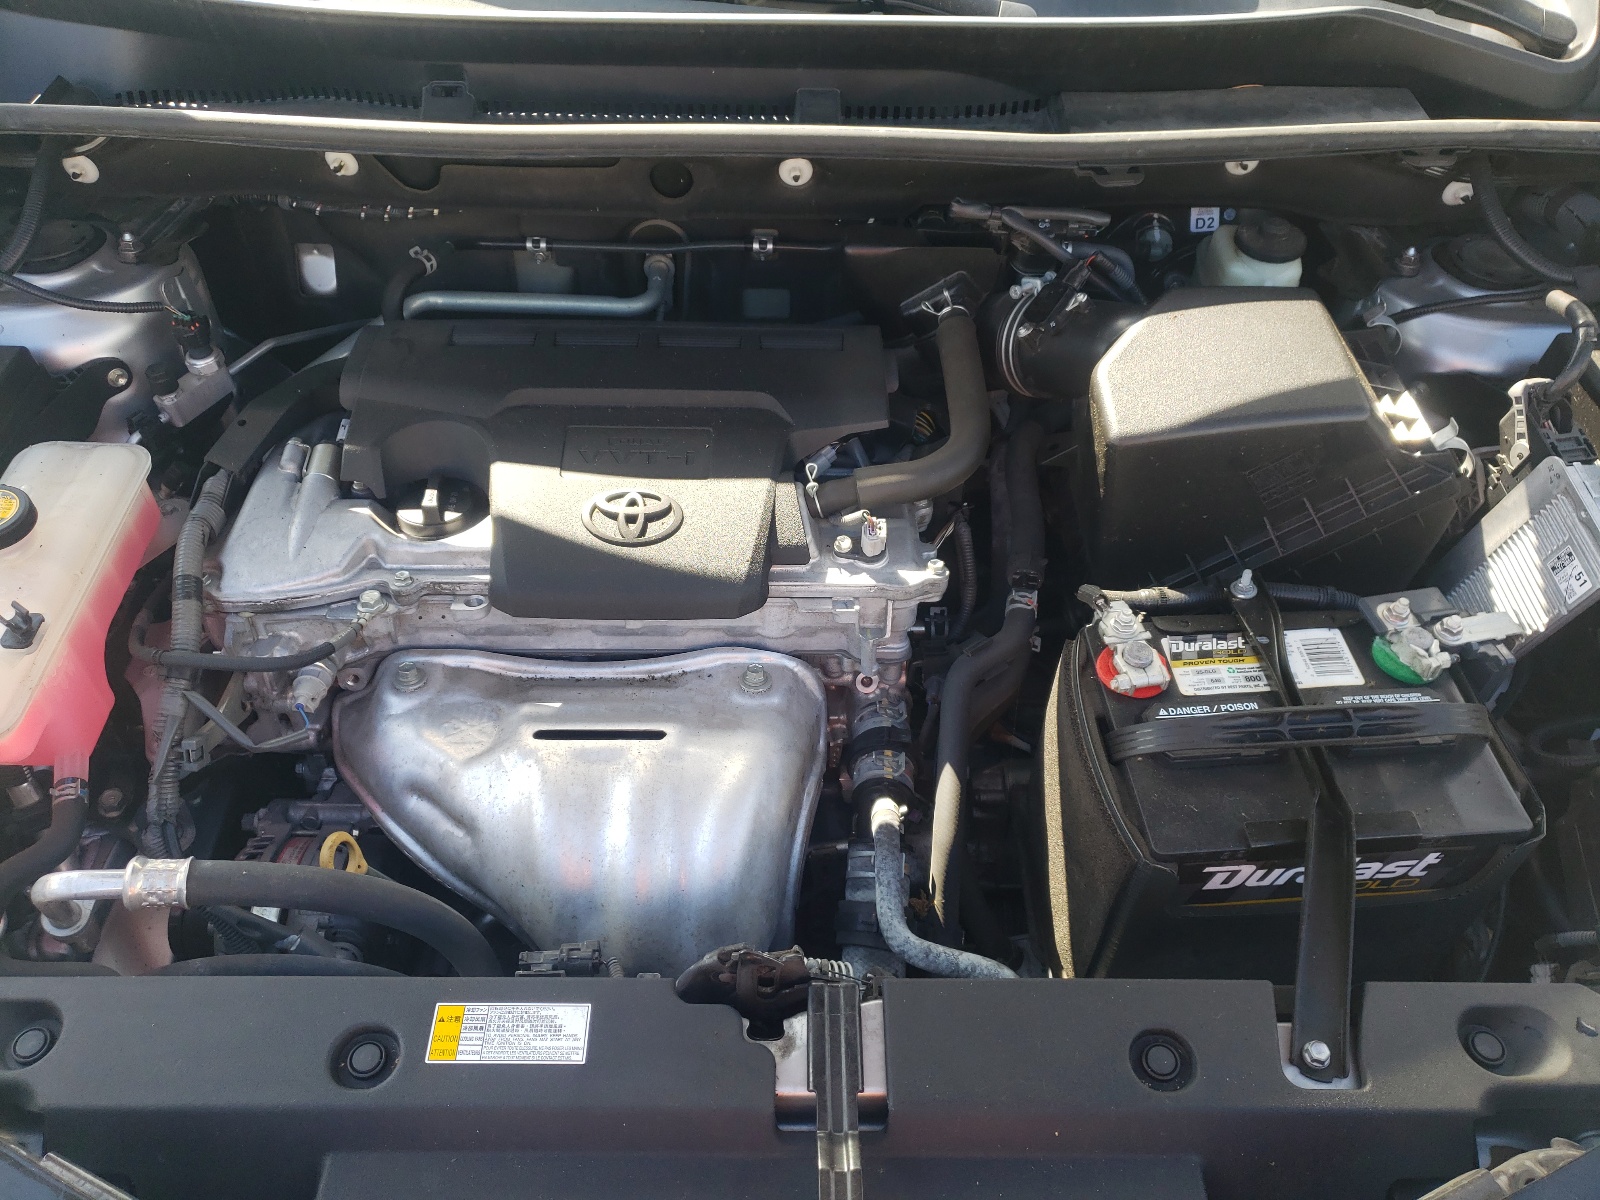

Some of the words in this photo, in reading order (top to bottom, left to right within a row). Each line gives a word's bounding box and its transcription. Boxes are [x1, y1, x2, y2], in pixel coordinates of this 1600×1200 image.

[1196, 217, 1215, 229] D2
[1574, 571, 1588, 588] 51
[1170, 637, 1246, 652] Duralast
[1168, 706, 1210, 715] DANGER
[1221, 702, 1258, 712] POISON
[1202, 852, 1442, 890] Durast
